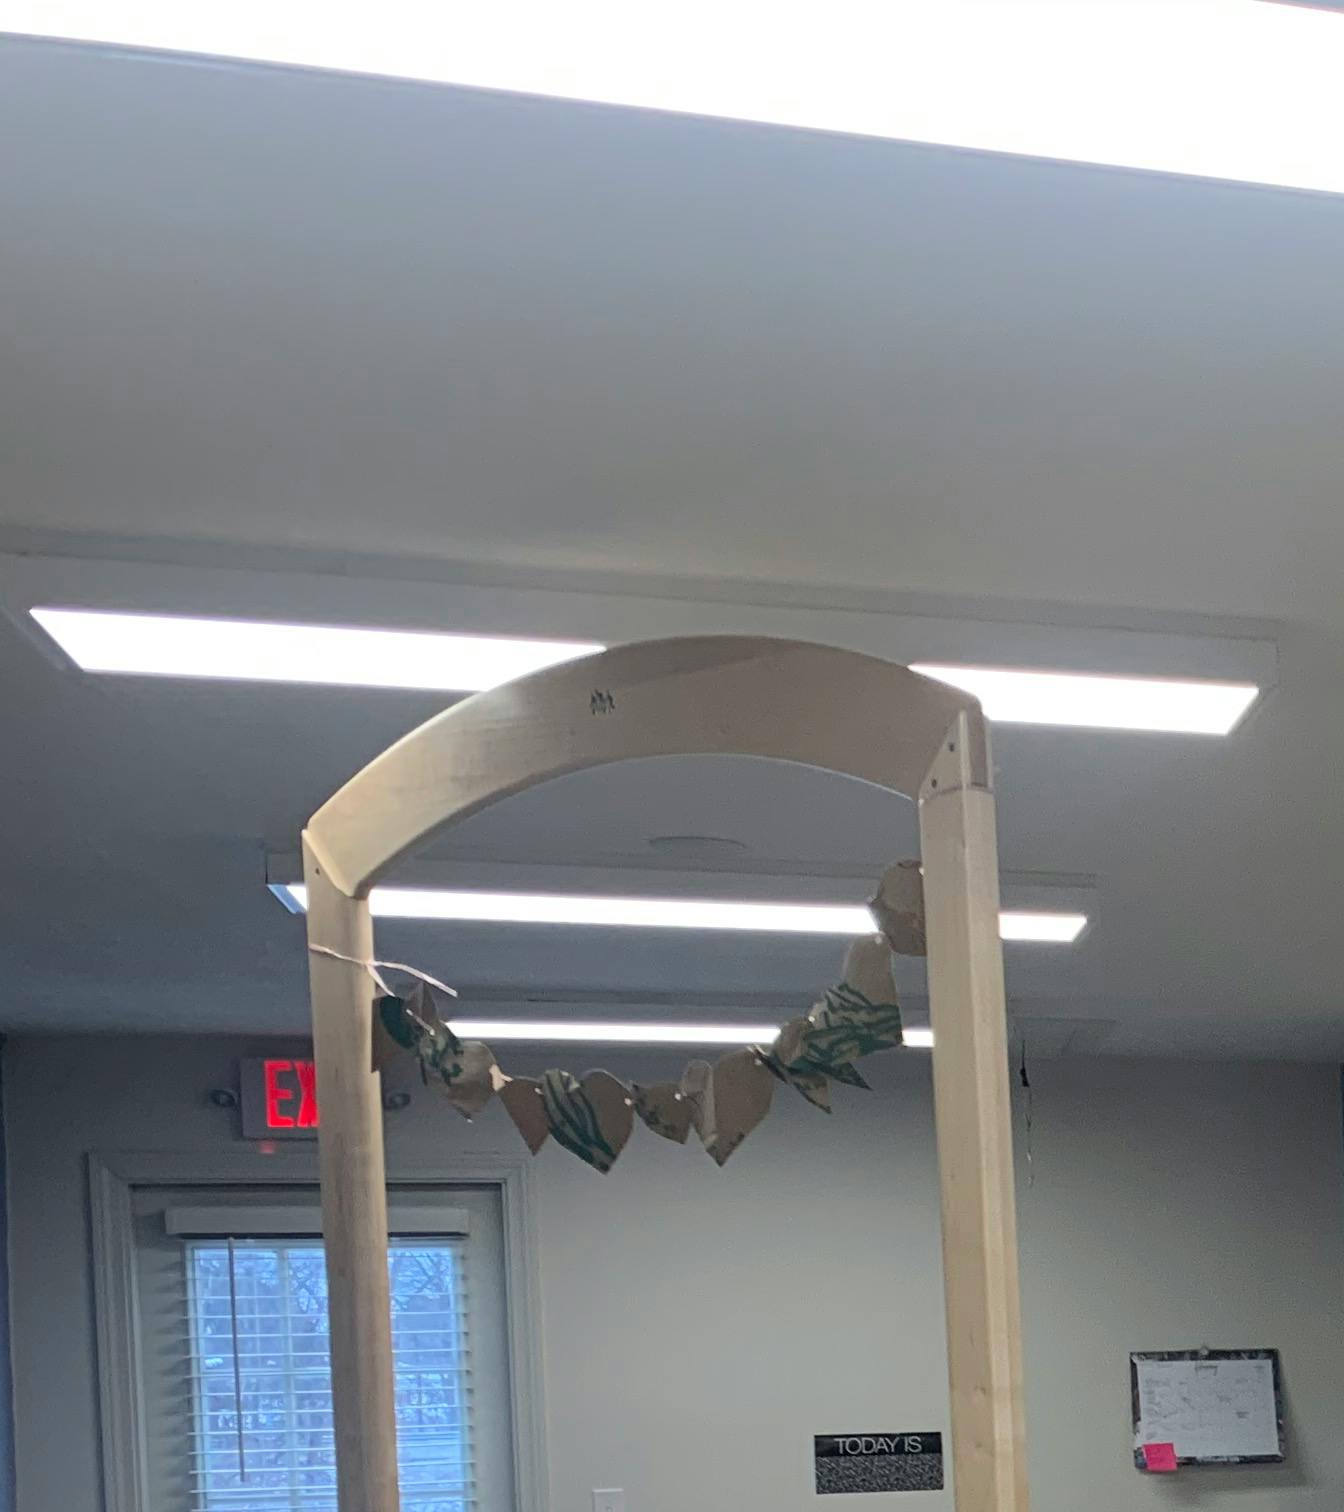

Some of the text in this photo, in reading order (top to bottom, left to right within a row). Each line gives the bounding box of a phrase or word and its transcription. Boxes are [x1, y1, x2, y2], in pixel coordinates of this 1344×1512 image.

[264, 1060, 319, 1128] EX
[833, 1435, 923, 1455] TODAY IS
